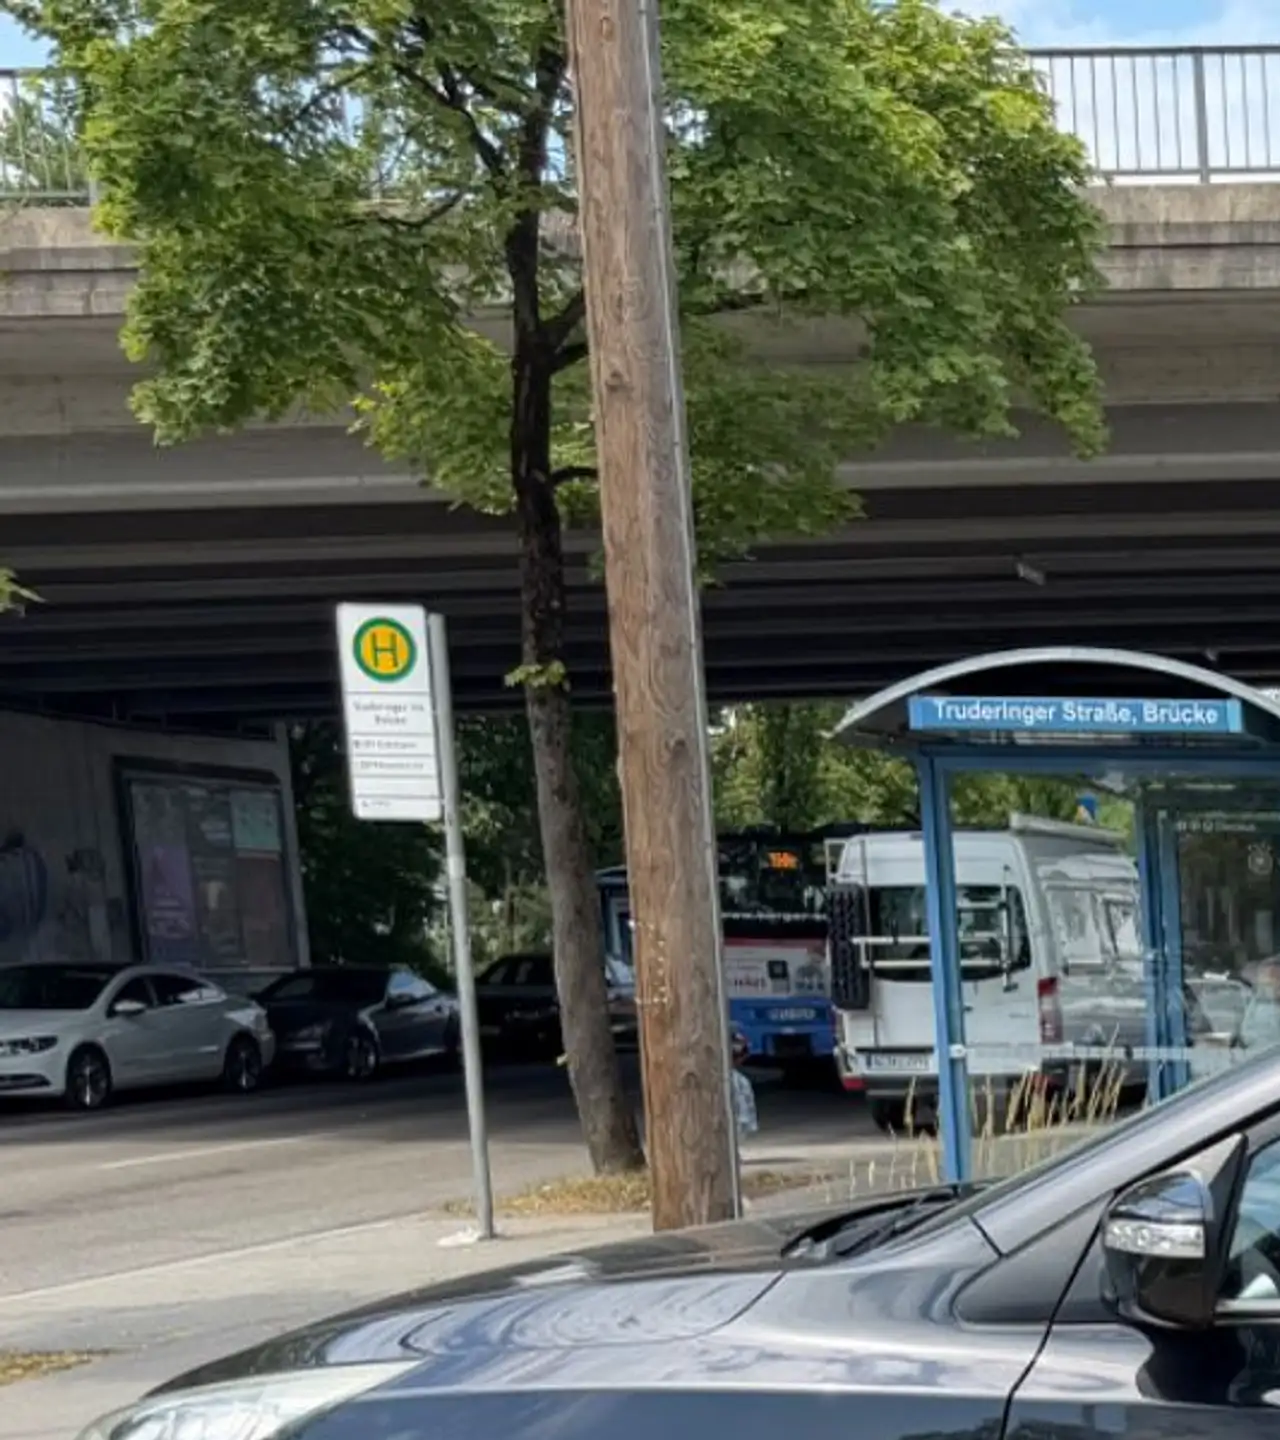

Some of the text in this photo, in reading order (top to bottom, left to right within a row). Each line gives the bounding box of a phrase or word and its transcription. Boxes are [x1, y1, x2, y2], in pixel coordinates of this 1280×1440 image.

[371, 631, 398, 668] H
[933, 701, 1219, 725] Truderinger Straße, Brücke
